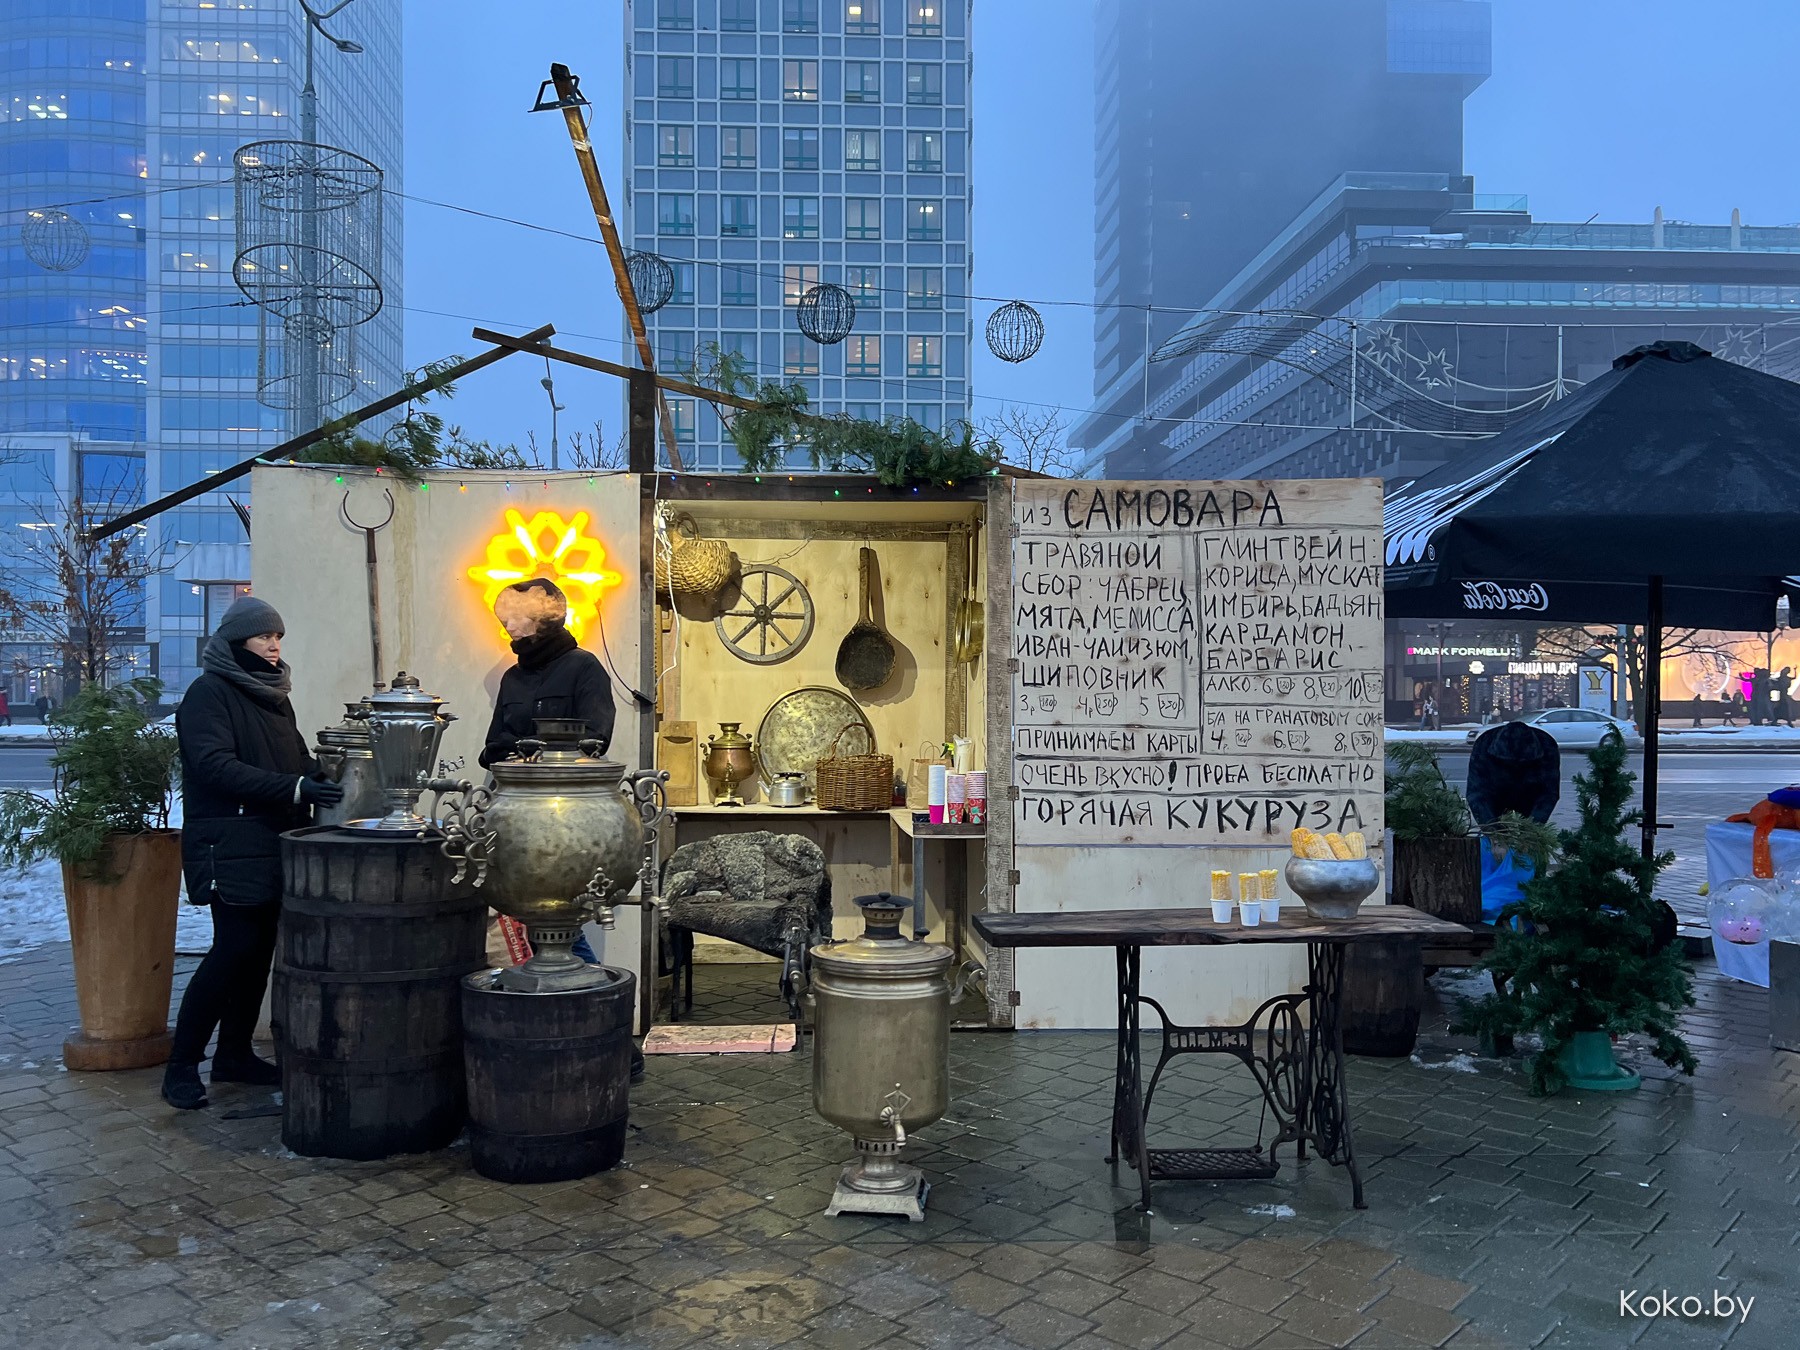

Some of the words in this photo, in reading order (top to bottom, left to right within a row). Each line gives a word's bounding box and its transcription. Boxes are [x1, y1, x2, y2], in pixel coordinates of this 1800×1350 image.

[1064, 487, 1284, 532] САМОВАРА
[1021, 540, 1161, 570] ТРАВЯНОЙ
[1207, 647, 1344, 670] БАРБАРИС
[1508, 662, 1542, 675] ПИЦЦА
[1543, 662, 1557, 674] НА
[1021, 662, 1167, 692] ШИПОВНИК
[1235, 709, 1250, 726] НА
[1255, 709, 1350, 727] ГРАНАТОВОМ
[1356, 711, 1383, 727] СОКЕ
[1018, 728, 1136, 752] ПРИНИМАЕМ
[1147, 731, 1198, 753] КАРТЫ
[1021, 763, 1088, 786] ОЧЕНЬ
[1096, 760, 1177, 792] ВКУСНО!
[1186, 763, 1250, 787] ПРОБА
[1262, 762, 1375, 786] БЕСПЛАТНО
[1023, 797, 1153, 828] ГОРЯЧАЯ
[1167, 798, 1368, 835] КУКУРУЗА
